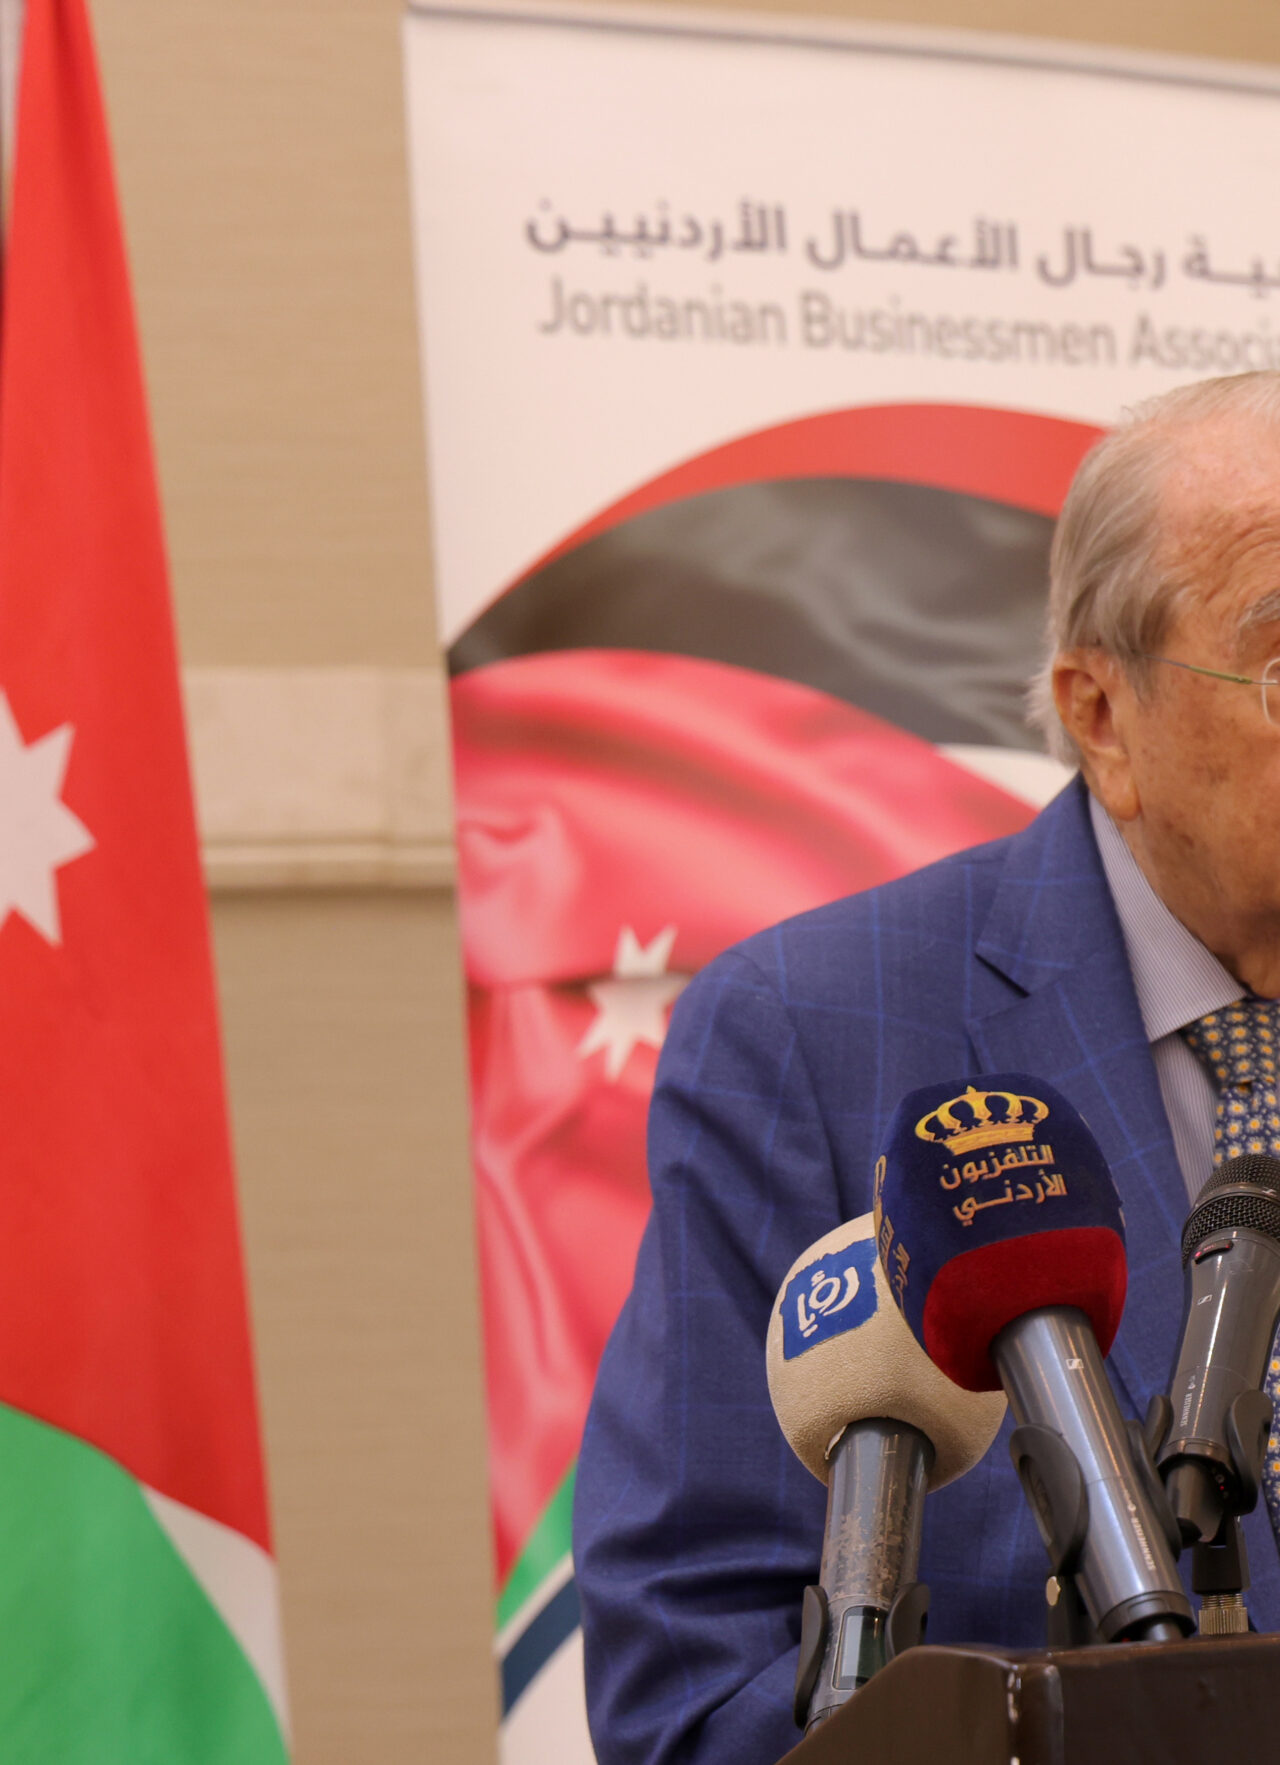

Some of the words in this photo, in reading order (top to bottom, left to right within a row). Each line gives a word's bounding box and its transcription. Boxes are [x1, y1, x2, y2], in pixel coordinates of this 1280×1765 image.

[524, 198, 788, 262] الأردنيين
[804, 208, 1020, 272] الأعمال
[1036, 225, 1165, 290] رجال
[537, 275, 788, 345] Jordanian
[801, 290, 1117, 367] Businessmen
[940, 1144, 1055, 1190] التلفزيون
[952, 1169, 1068, 1227] الأردني
[1131, 1517, 1156, 1570] SENNHEISER
